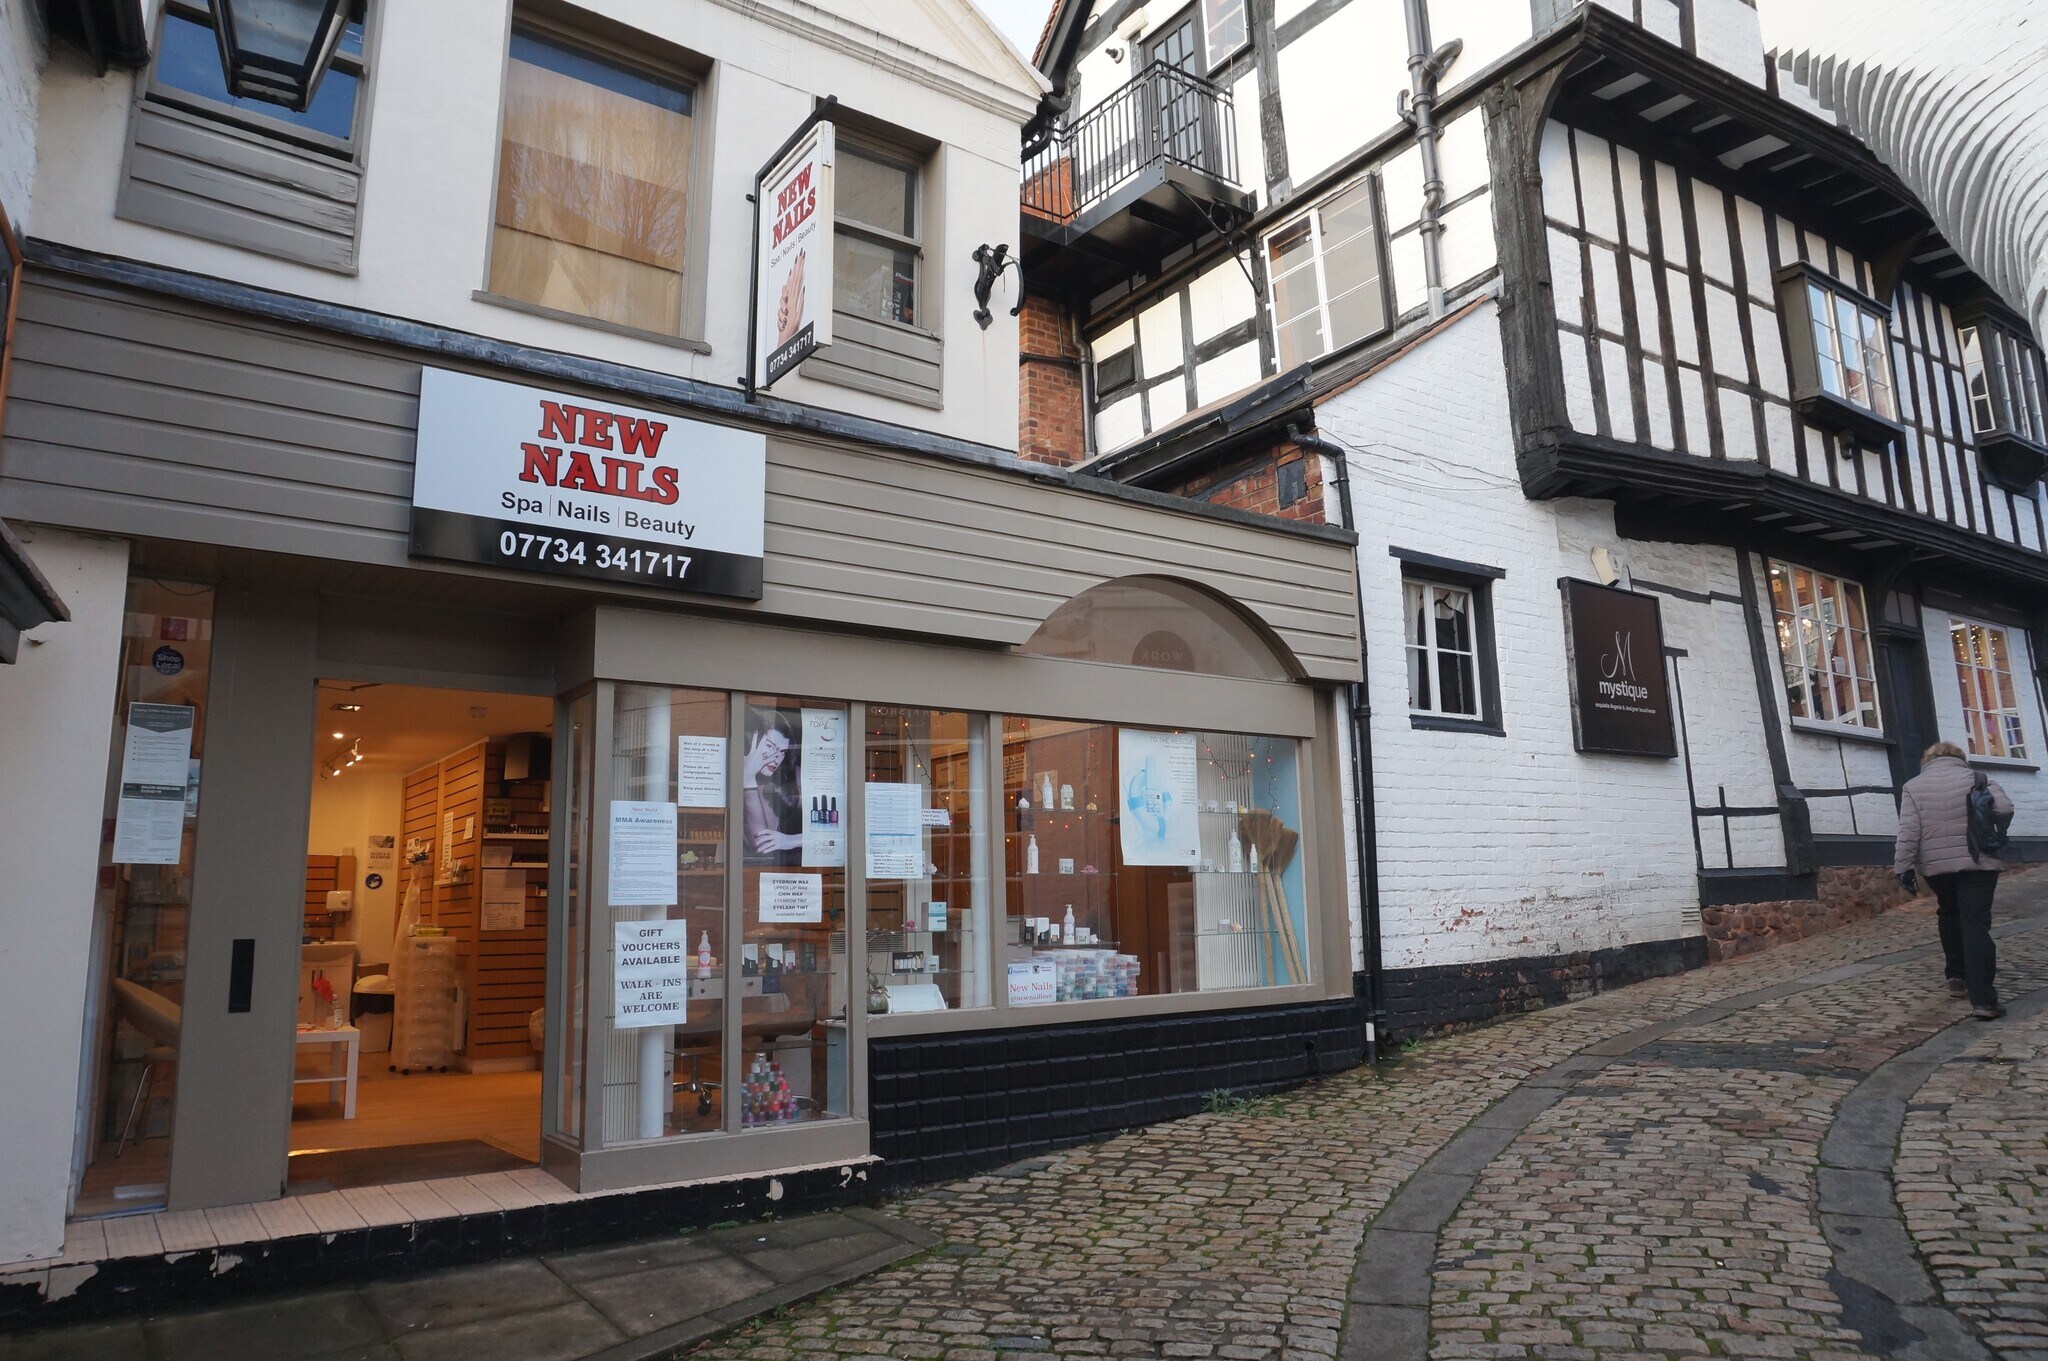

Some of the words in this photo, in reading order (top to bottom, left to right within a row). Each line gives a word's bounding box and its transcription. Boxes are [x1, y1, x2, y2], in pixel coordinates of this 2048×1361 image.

[777, 162, 813, 218] NEW
[772, 186, 815, 250] NAILS
[771, 255, 780, 268] Spa
[782, 241, 795, 256] Nails
[798, 221, 816, 243] Beauty
[770, 350, 788, 373] 07734
[788, 331, 812, 358] 341717
[538, 400, 668, 458] NEW
[519, 443, 680, 505] NAILS
[501, 492, 543, 517] Spa
[557, 500, 611, 524] Nails
[624, 511, 695, 540] Beauty
[500, 531, 587, 566] 07734
[595, 544, 692, 579] 341717
[156, 661, 181, 669] Local
[157, 653, 181, 663] Shop
[1599, 680, 1648, 702] mystique
[820, 717, 840, 742] 5
[1171, 737, 1194, 745] RESCUE
[639, 929, 663, 937] GIFT
[622, 942, 680, 952] VOUCHERS
[621, 955, 680, 966] AVAILABLE
[621, 980, 653, 990] WALK
[662, 978, 682, 987] INS
[1010, 983, 1029, 993] New
[1031, 982, 1054, 992] Nails
[639, 991, 663, 1001] ARE
[622, 1002, 680, 1014] WELCOME
